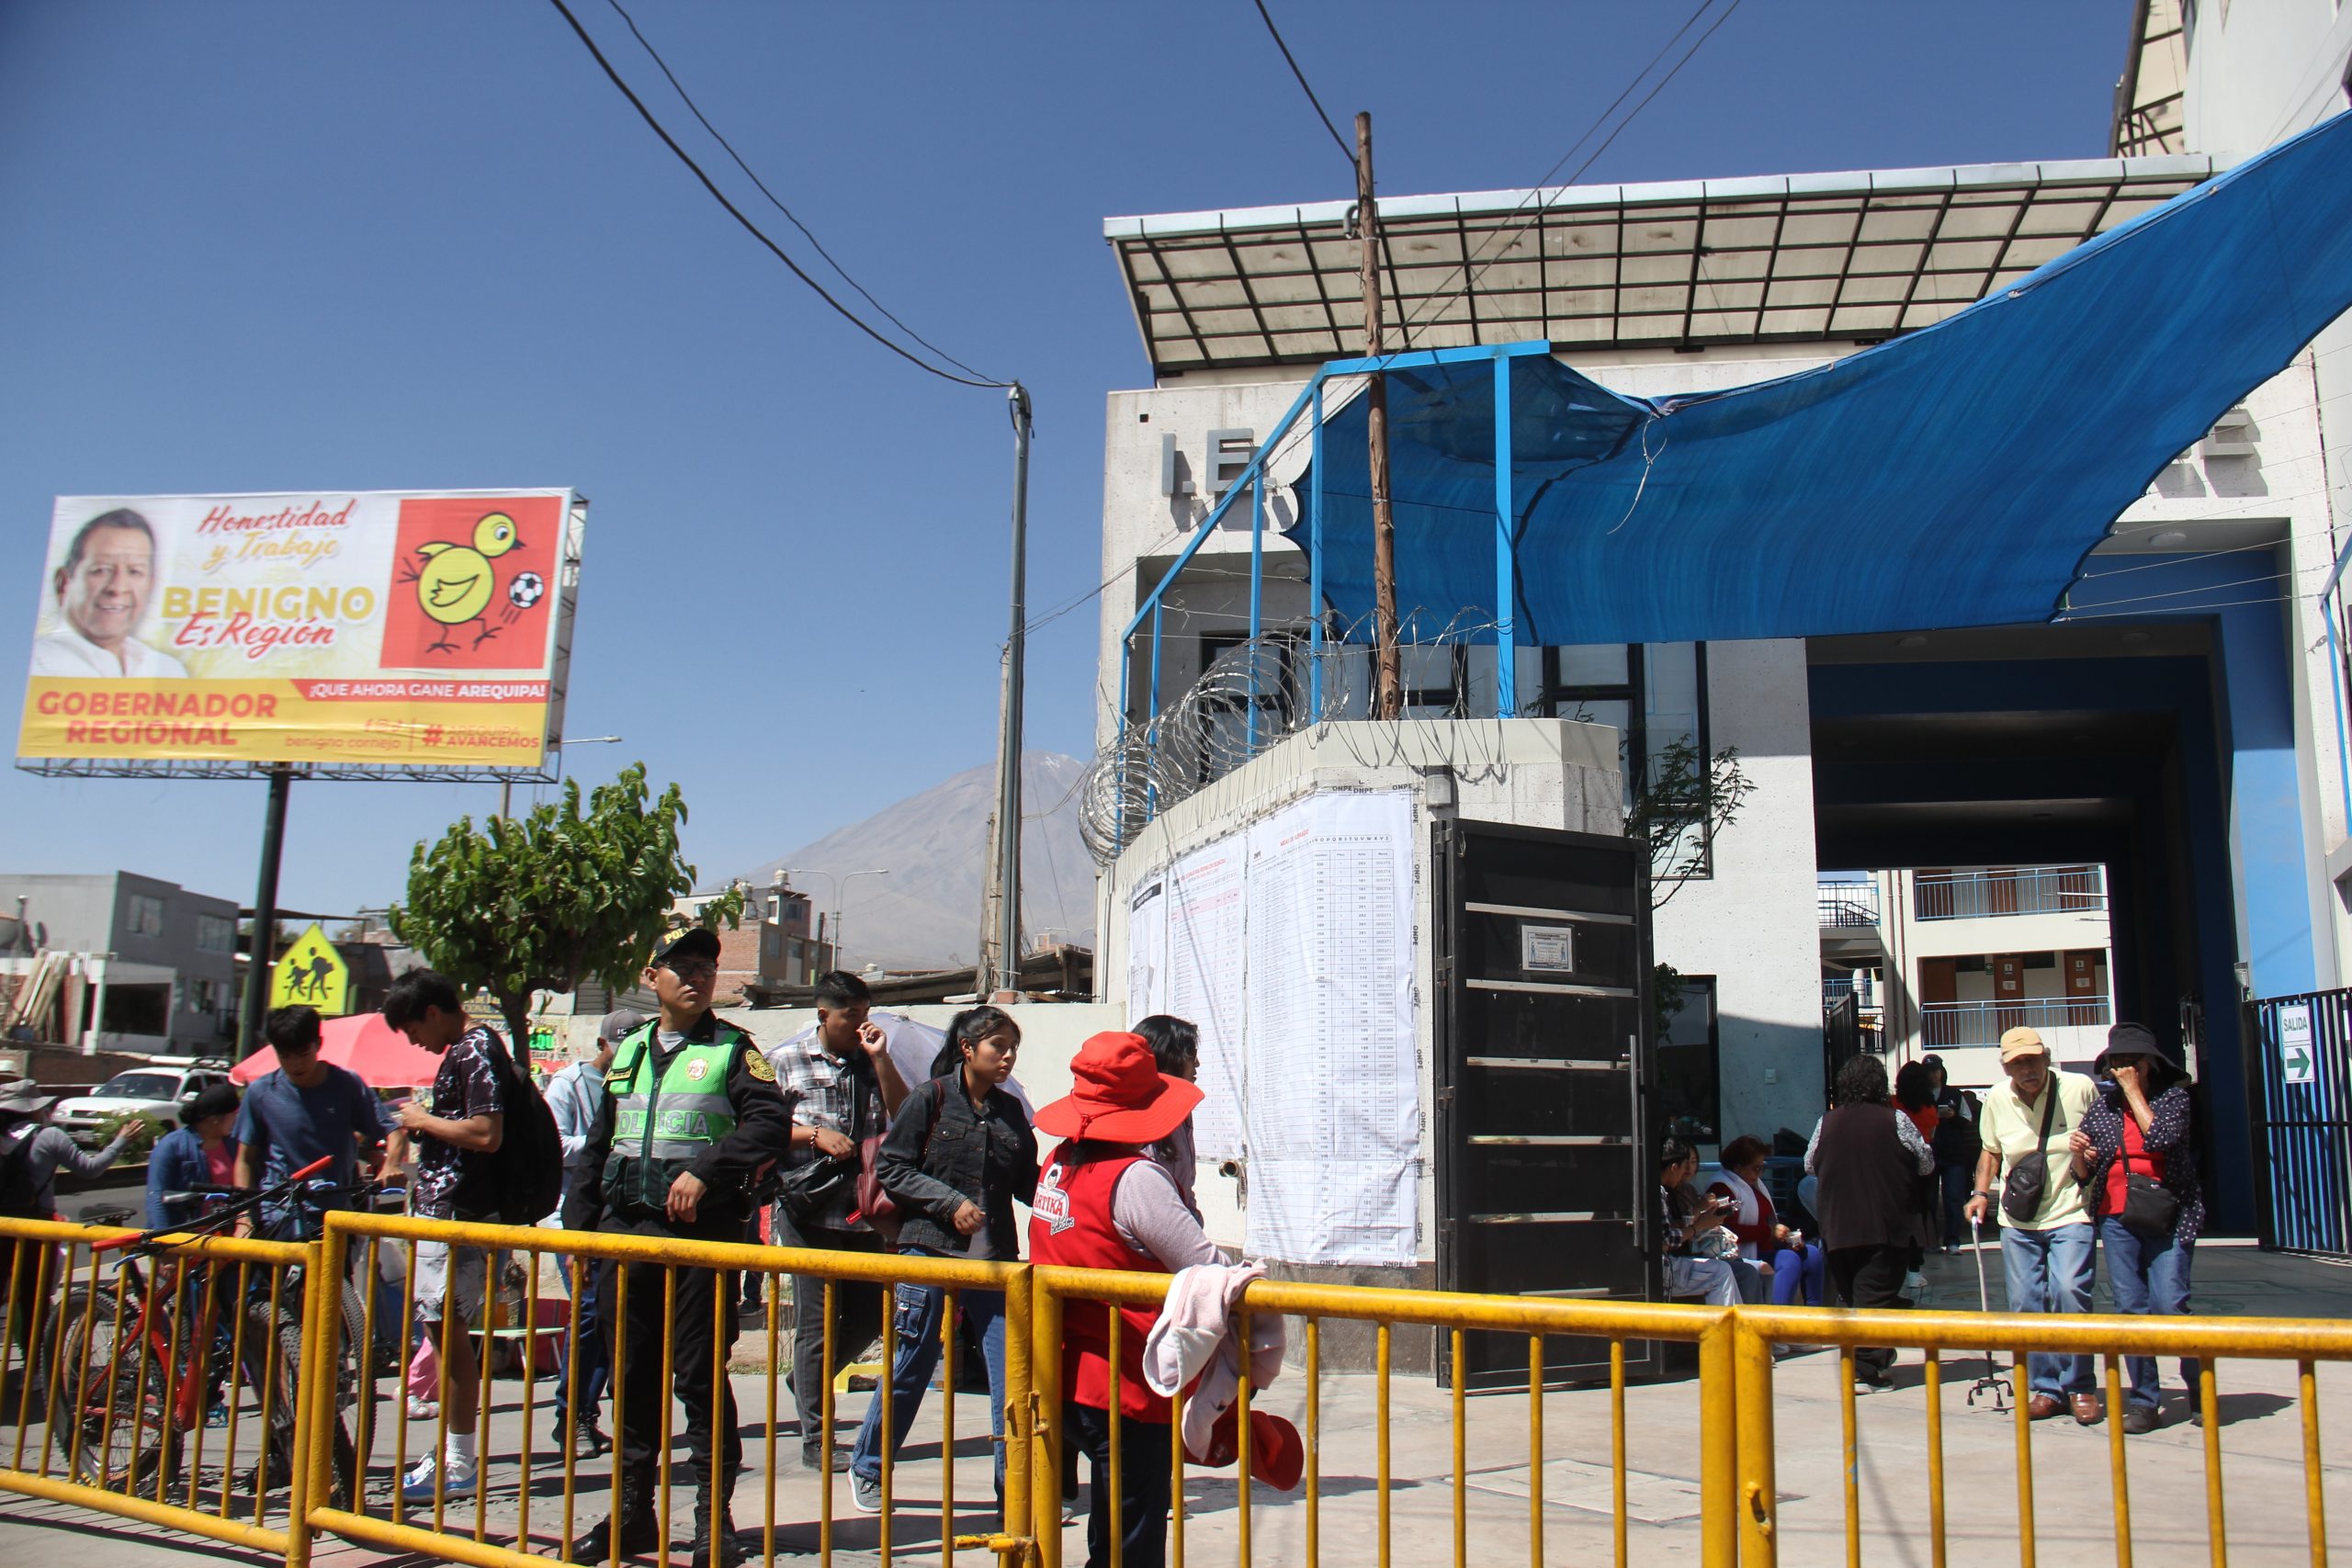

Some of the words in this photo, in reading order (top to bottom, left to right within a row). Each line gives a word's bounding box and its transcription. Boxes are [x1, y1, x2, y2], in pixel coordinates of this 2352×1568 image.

[196, 499, 357, 534] Honestidad
[201, 545, 229, 570] y
[236, 529, 338, 566] Trabajo
[161, 586, 375, 619] BENIGNO
[175, 611, 219, 646] Es
[216, 611, 334, 659] Región
[37, 691, 278, 718] GOBERNADOR
[309, 683, 348, 698] ¡QUE
[351, 683, 406, 696] AHORA
[409, 683, 455, 697] GANE
[457, 684, 546, 700] AREQUIPA!
[65, 720, 238, 746] REGIONAL
[2283, 1016, 2308, 1031] SALIDA
[615, 1111, 709, 1134] OLICIA
[1034, 1192, 1063, 1217] ARTIKA
